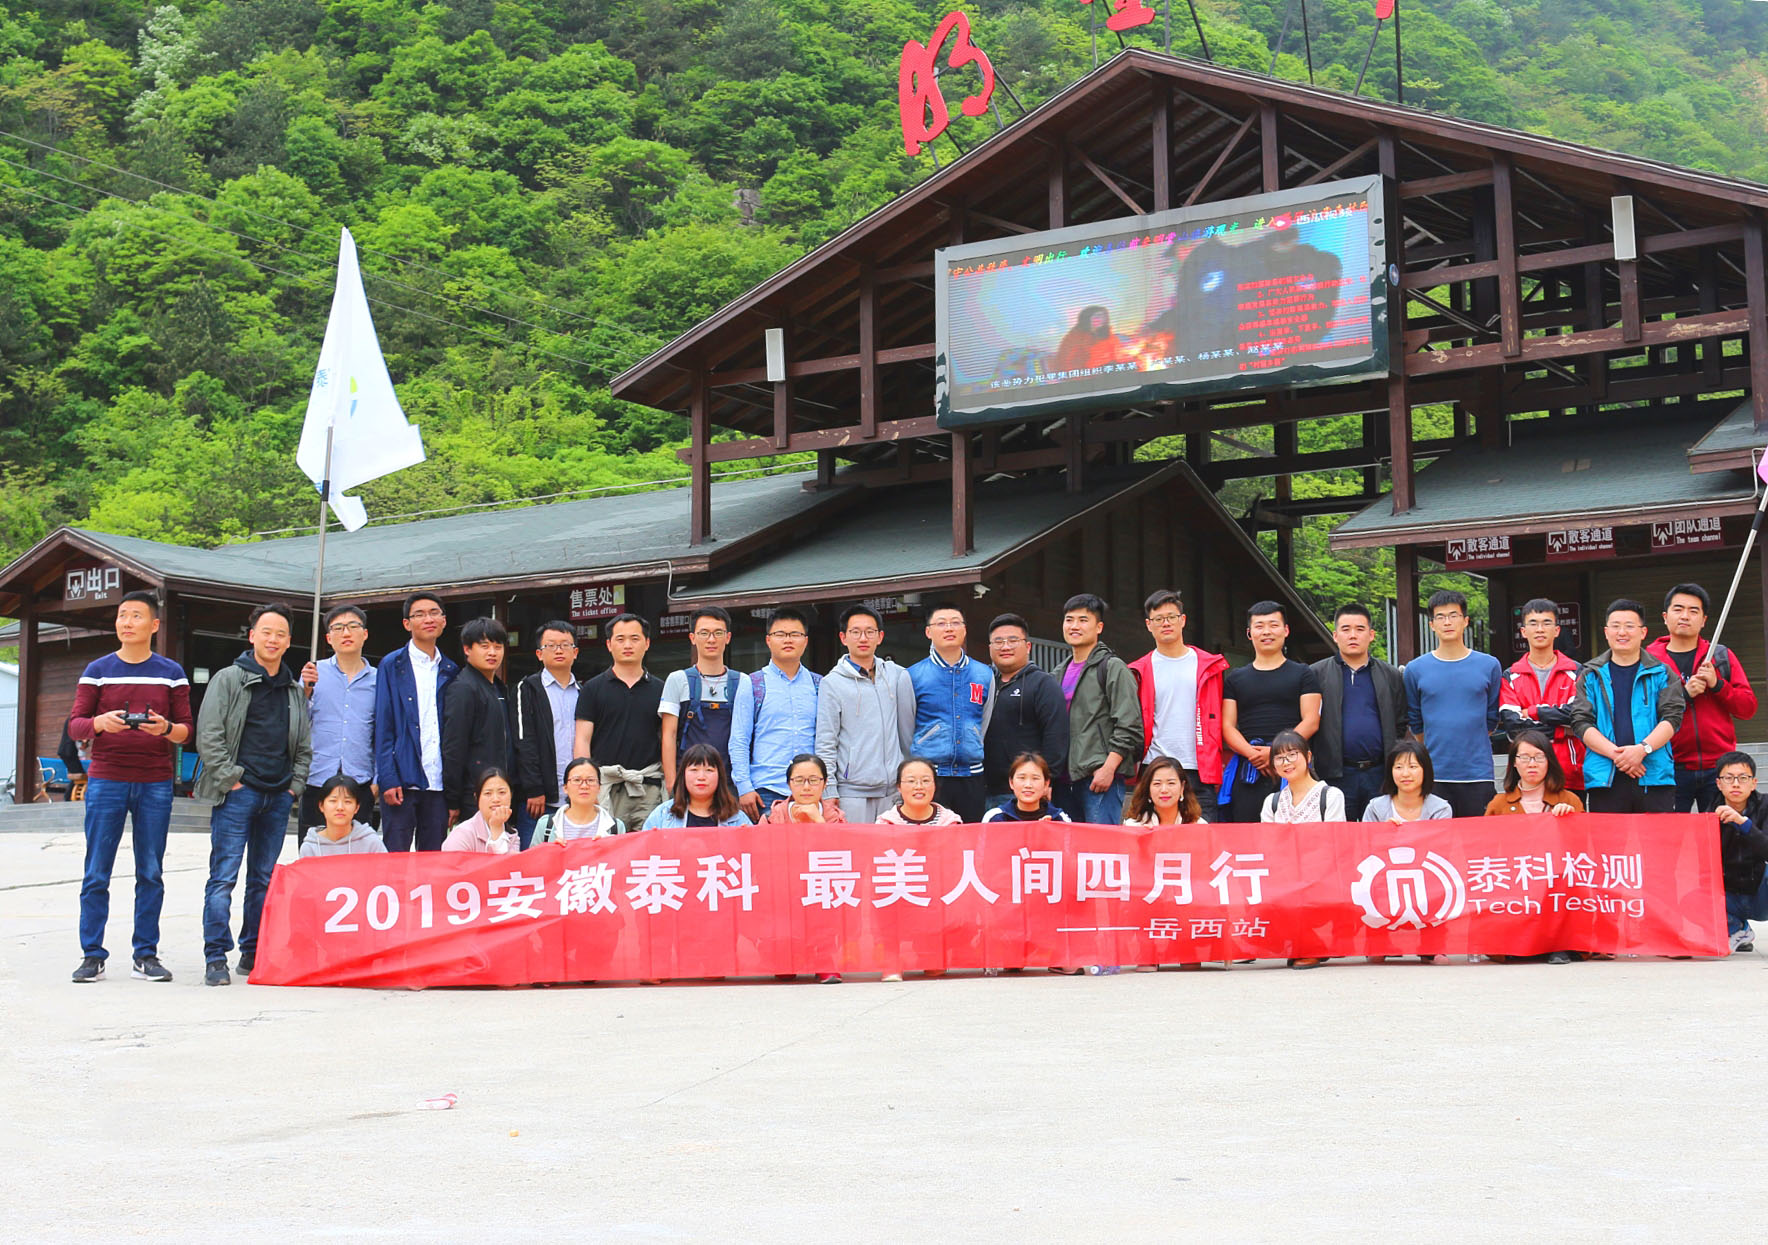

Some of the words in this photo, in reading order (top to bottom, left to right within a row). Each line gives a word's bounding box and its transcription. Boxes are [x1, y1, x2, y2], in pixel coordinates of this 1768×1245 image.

[1568, 527, 1613, 545] 散客通道
[1674, 517, 1721, 535] 团队通道
[1466, 535, 1510, 553] 散客通道
[1676, 536, 1685, 544] The
[1687, 535, 1699, 544] team
[1701, 532, 1721, 542] channel
[87, 567, 120, 592] 出口
[95, 592, 108, 600] Exit
[570, 586, 613, 609] 售票处
[572, 610, 580, 618] The
[582, 609, 599, 617] ticket
[600, 607, 617, 616] office
[970, 682, 984, 705] M
[1467, 851, 1644, 893] 泰科检测
[324, 853, 760, 934] 2019安徽泰科
[799, 847, 1270, 910] 最美人间四月行
[1468, 895, 1541, 916] Tech
[1548, 892, 1645, 918] Testing
